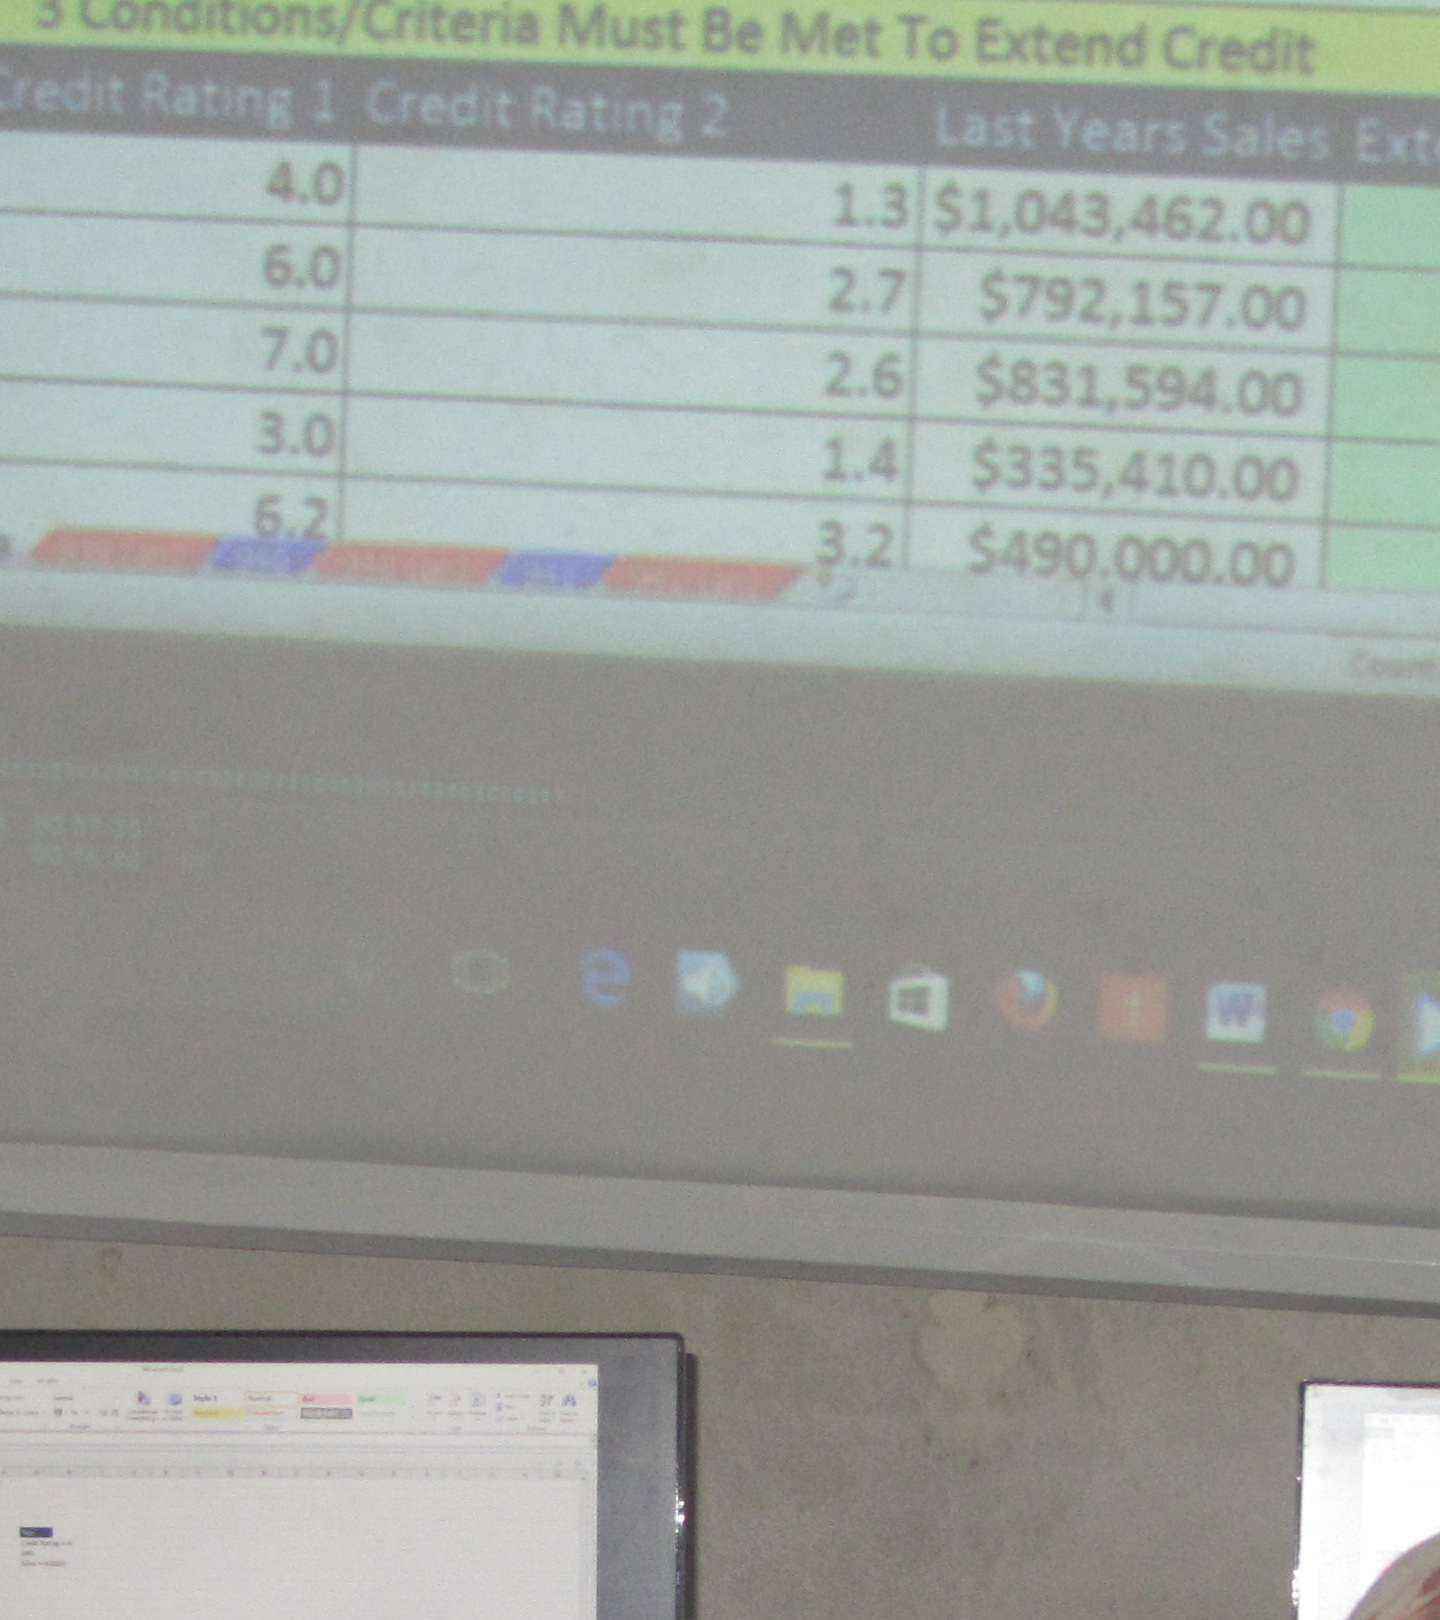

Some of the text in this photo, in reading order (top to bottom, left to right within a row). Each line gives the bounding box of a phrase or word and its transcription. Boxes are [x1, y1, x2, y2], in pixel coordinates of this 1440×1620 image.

[558, 14, 691, 55] Must
[702, 16, 765, 56] Be
[780, 17, 885, 59] Met
[901, 17, 960, 62] To
[976, 20, 1148, 69] Extend
[1162, 26, 1316, 76] Credit
[143, 70, 294, 131] Rating
[312, 78, 333, 123] 1
[366, 81, 730, 145] Credit Rating 2
[937, 105, 1332, 162] Last Years Sales
[266, 159, 346, 205] 4.0
[832, 181, 912, 228] 1.3
[934, 186, 1312, 246] $1,043,462.00
[263, 244, 341, 288] 6.0
[829, 267, 908, 314] 2.7
[979, 266, 1308, 332] $792,157.00
[262, 327, 340, 372] 7.0
[824, 352, 904, 397] 2.6
[975, 350, 1304, 418] $831,594.00
[257, 412, 335, 458] 3.0
[822, 436, 901, 481] 1.4
[971, 436, 1300, 504] $335,410.00
[252, 495, 330, 539] 6.2
[818, 522, 896, 569] 3.2
